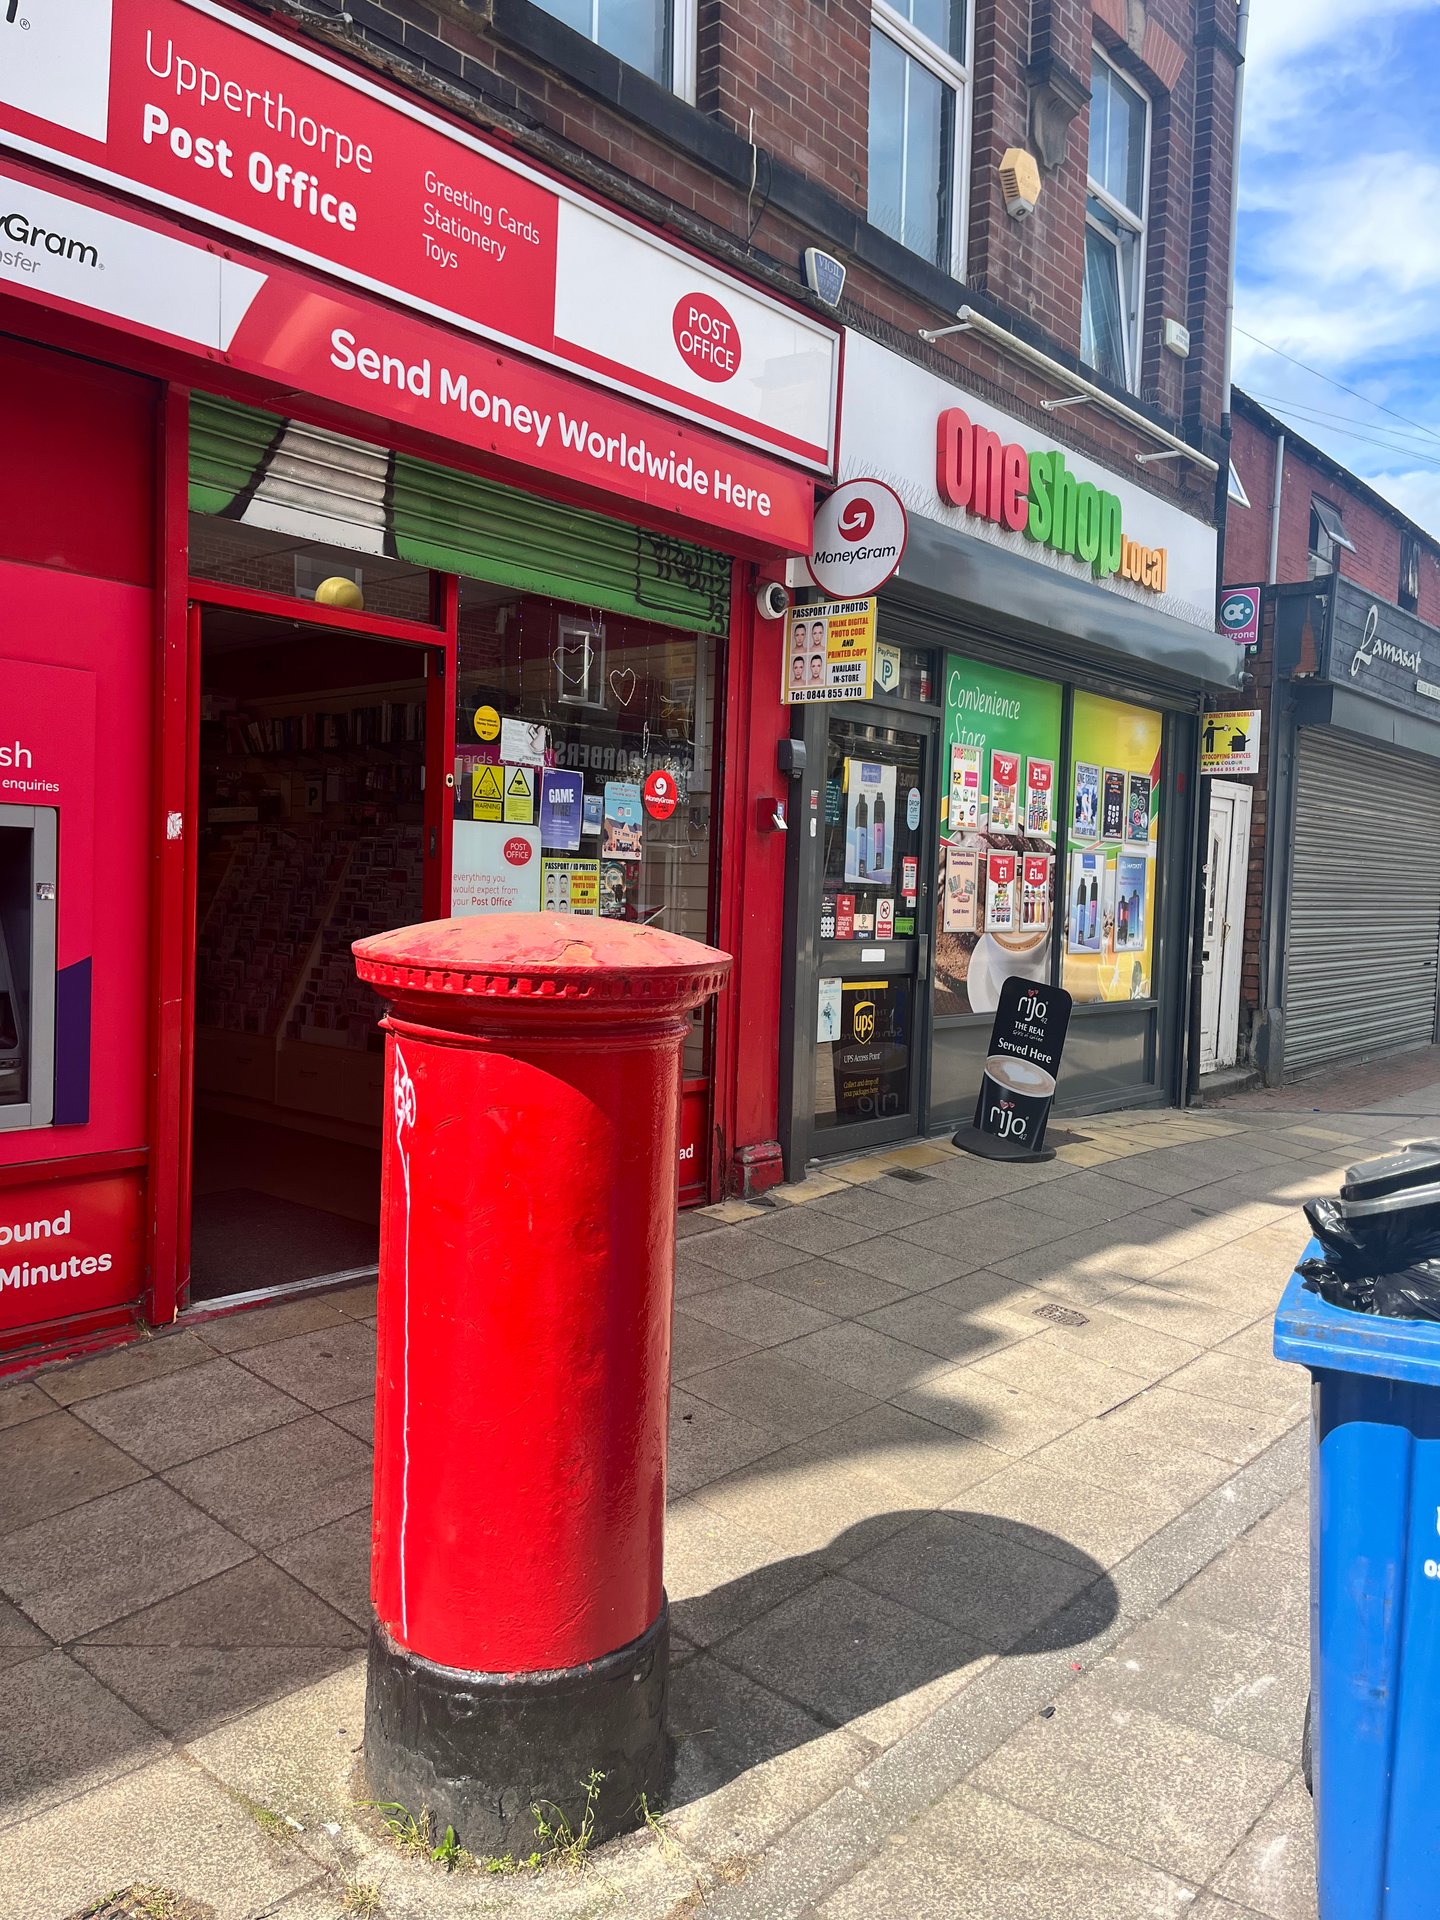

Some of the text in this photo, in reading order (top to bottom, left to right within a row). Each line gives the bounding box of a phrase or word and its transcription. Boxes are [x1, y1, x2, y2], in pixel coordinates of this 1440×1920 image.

[146, 30, 373, 173] Upperthorpe
[143, 103, 357, 231] Post Office
[425, 171, 539, 244] Greeting Cards
[424, 202, 506, 262] Stationery
[0, 214, 98, 267] Gram
[422, 233, 458, 268] Toys
[0, 250, 41, 272] sfer
[689, 307, 731, 342] POST
[680, 332, 734, 373] OFFICE
[330, 328, 771, 517] Send Money Worldwide Here
[814, 544, 895, 565] MoneyGram
[792, 606, 826, 618] PASSPORT
[841, 602, 868, 612] PHOTOS
[829, 617, 868, 628] ONLINE DIGITAL
[831, 628, 865, 637] PHOTO CODE
[842, 639, 854, 647] AND
[1350, 605, 1422, 677] Lamasat
[828, 650, 851, 659] PRINTED
[832, 664, 861, 673] AVAILABLE
[833, 674, 859, 683] IN-STORE
[792, 688, 862, 700] Tel: 0844 855 4710
[948, 670, 1020, 719] Convenience
[950, 713, 986, 746] Store
[0, 741, 32, 768] sh
[1033, 768, 1047, 781] £1.99
[2, 779, 60, 792] enquiries
[549, 789, 574, 803] GAME
[646, 794, 674, 805] MoneyGram
[475, 802, 500, 810] WARNING
[506, 851, 528, 859] OFFICE
[545, 863, 569, 871] PASSPORT
[579, 863, 597, 871] PHOTOS
[1000, 867, 1007, 878] £1
[1029, 868, 1043, 880] £1.80
[454, 873, 505, 883] everything you
[477, 887, 500, 896] expect
[453, 897, 512, 906] your Post Office
[1018, 997, 1046, 1021] rijo
[856, 1015, 873, 1038] ups
[1015, 1021, 1044, 1036] THE REAL
[844, 1052, 880, 1063] UPS Access Point
[998, 1038, 1052, 1063] Served Here
[853, 1089, 869, 1097] packages
[990, 1106, 1026, 1138] rijo
[0, 1253, 112, 1292] Minutes
